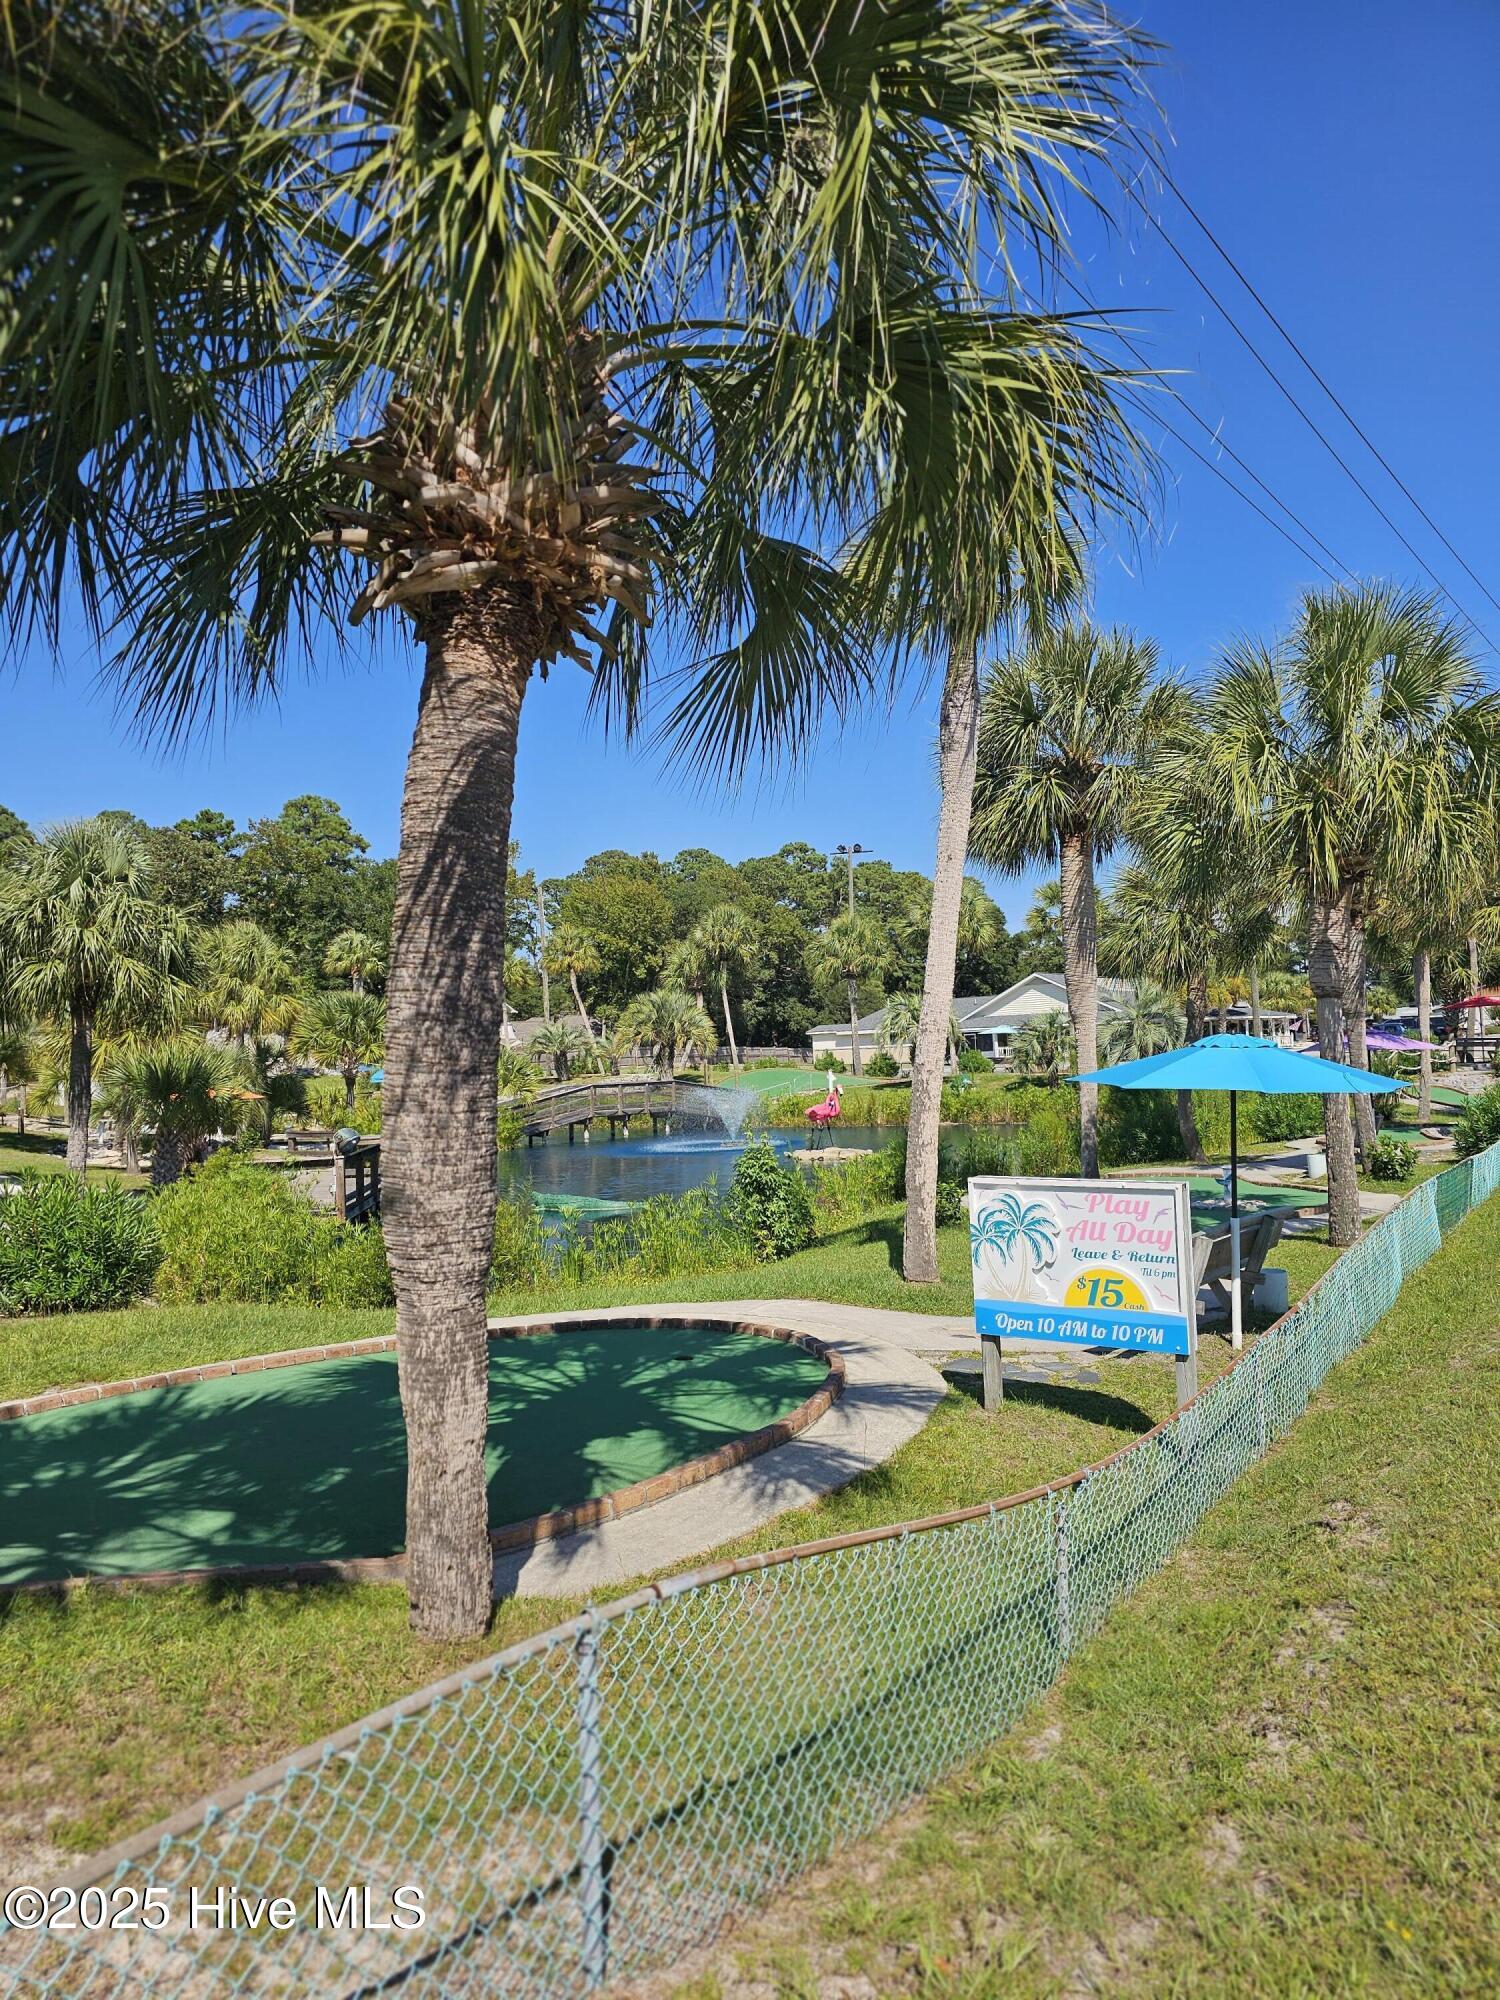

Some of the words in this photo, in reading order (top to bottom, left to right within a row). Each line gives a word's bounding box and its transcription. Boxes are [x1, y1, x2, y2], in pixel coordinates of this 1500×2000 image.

[1084, 1192, 1150, 1222] Play
[1066, 1220, 1107, 1243] All
[1113, 1221, 1174, 1252] Day
[1071, 1247, 1108, 1261] Leave
[1111, 1249, 1123, 1261] &
[1127, 1250, 1176, 1264] Return
[1161, 1271, 1176, 1280] pm
[1077, 1276, 1124, 1308] $15
[1124, 1303, 1145, 1311] Cash
[995, 1312, 1034, 1335] Open
[1036, 1318, 1055, 1334] 10
[1057, 1319, 1088, 1338] AM
[1091, 1323, 1107, 1339] to
[1112, 1324, 1131, 1342] 10
[1133, 1326, 1164, 1345] PM
